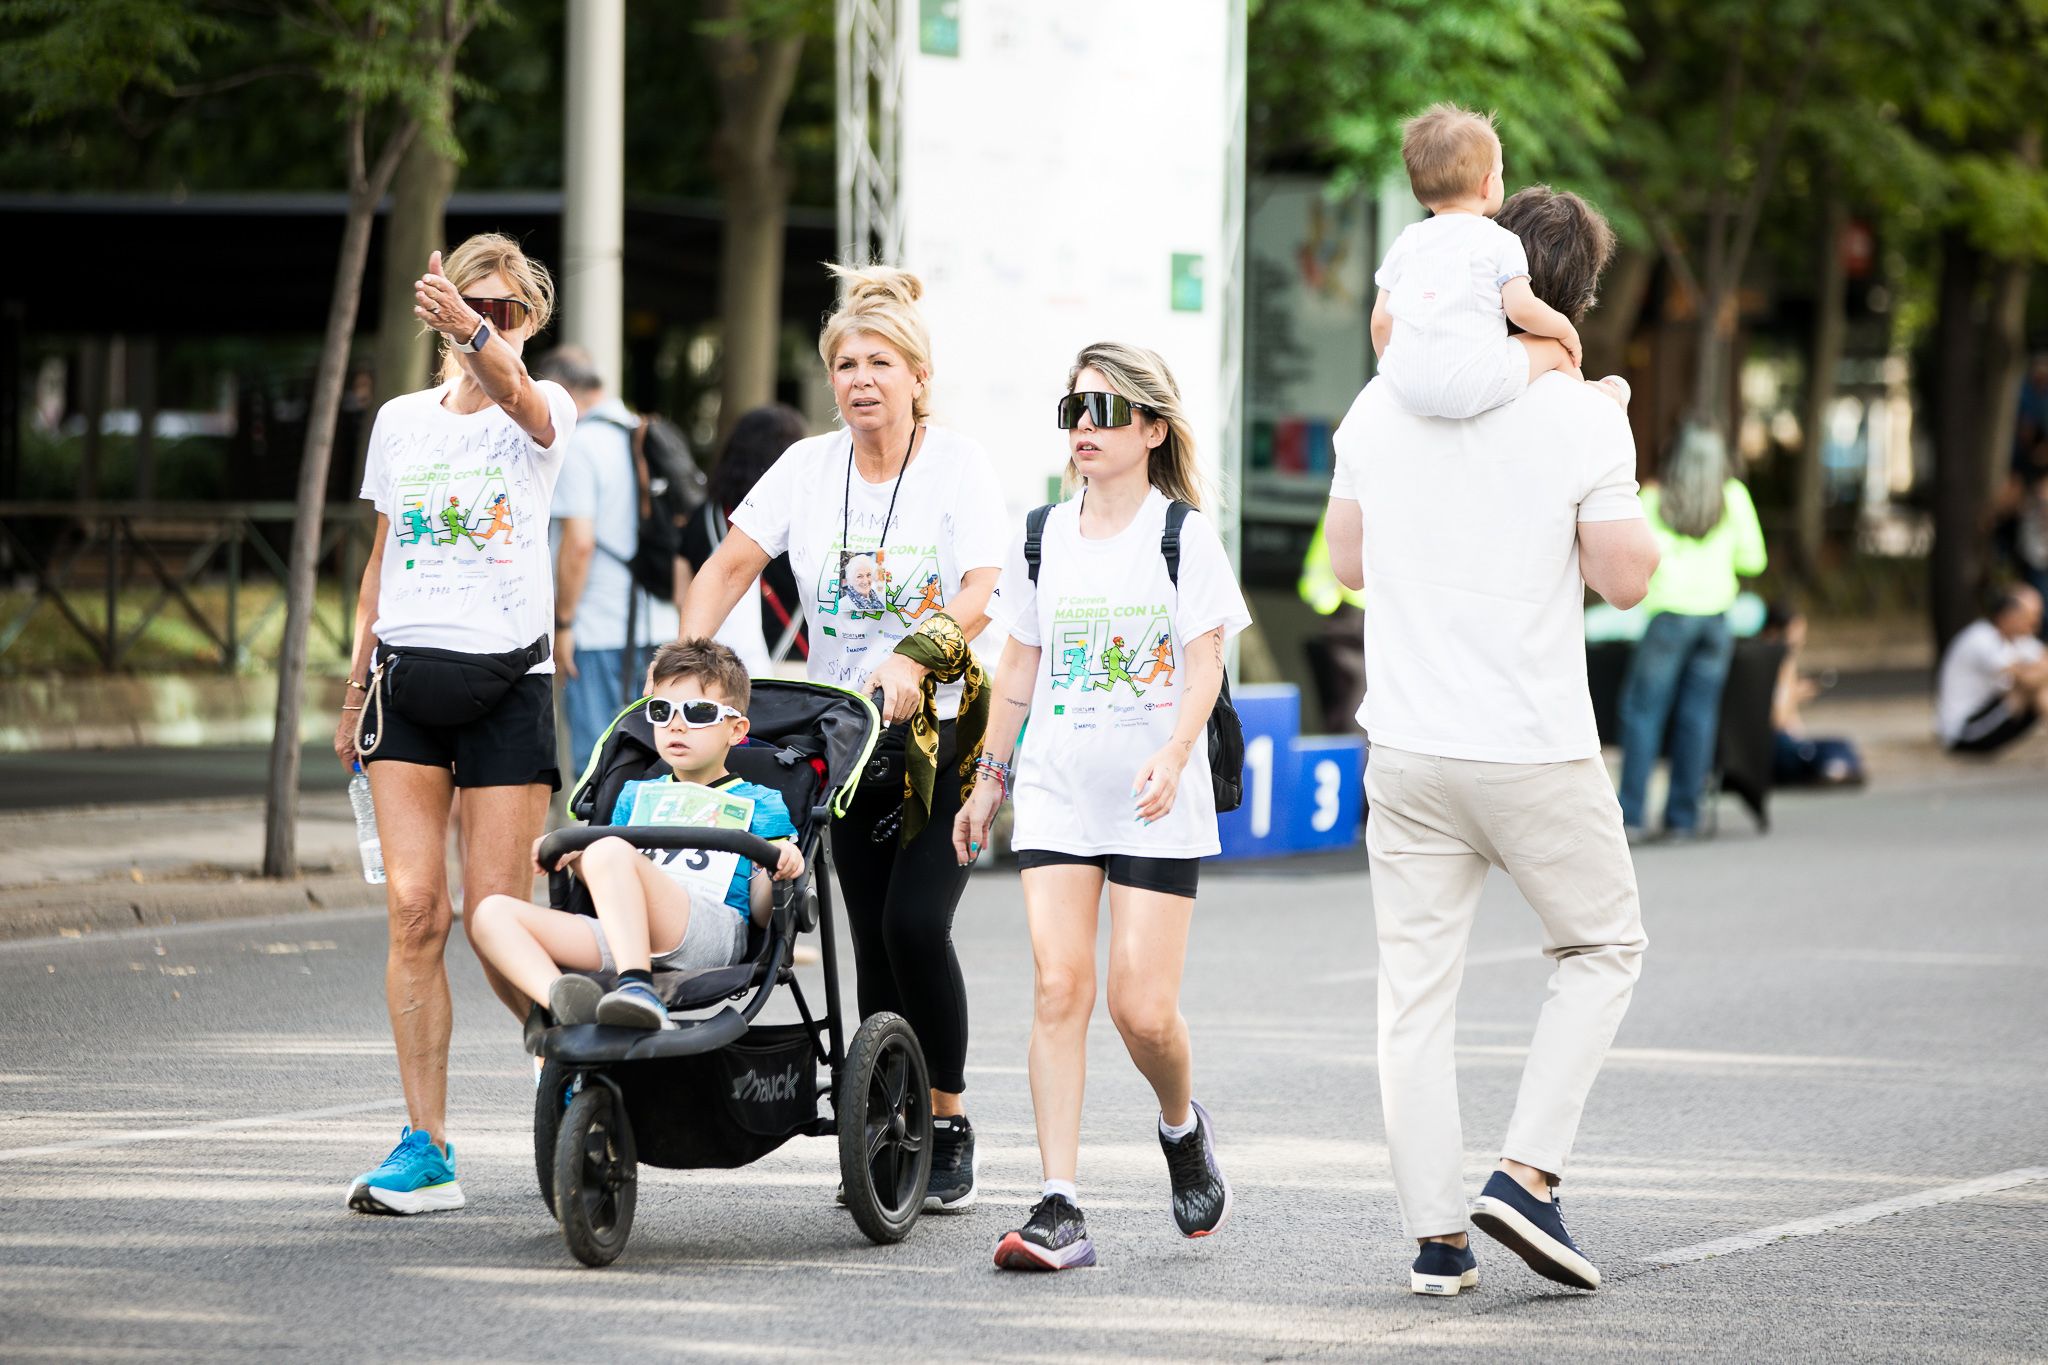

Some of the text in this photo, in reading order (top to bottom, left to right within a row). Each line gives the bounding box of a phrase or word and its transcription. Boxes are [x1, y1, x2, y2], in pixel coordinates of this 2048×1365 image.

[485, 466, 502, 476] LA
[888, 545, 917, 555] CON
[921, 545, 937, 555] LA
[1054, 604, 1168, 619] MADRID CON LA
[1069, 596, 1107, 605] Carrera
[1051, 616, 1175, 676] ELA
[1247, 735, 1273, 838] 1
[1311, 759, 1341, 832] 3
[650, 795, 721, 828] ELA
